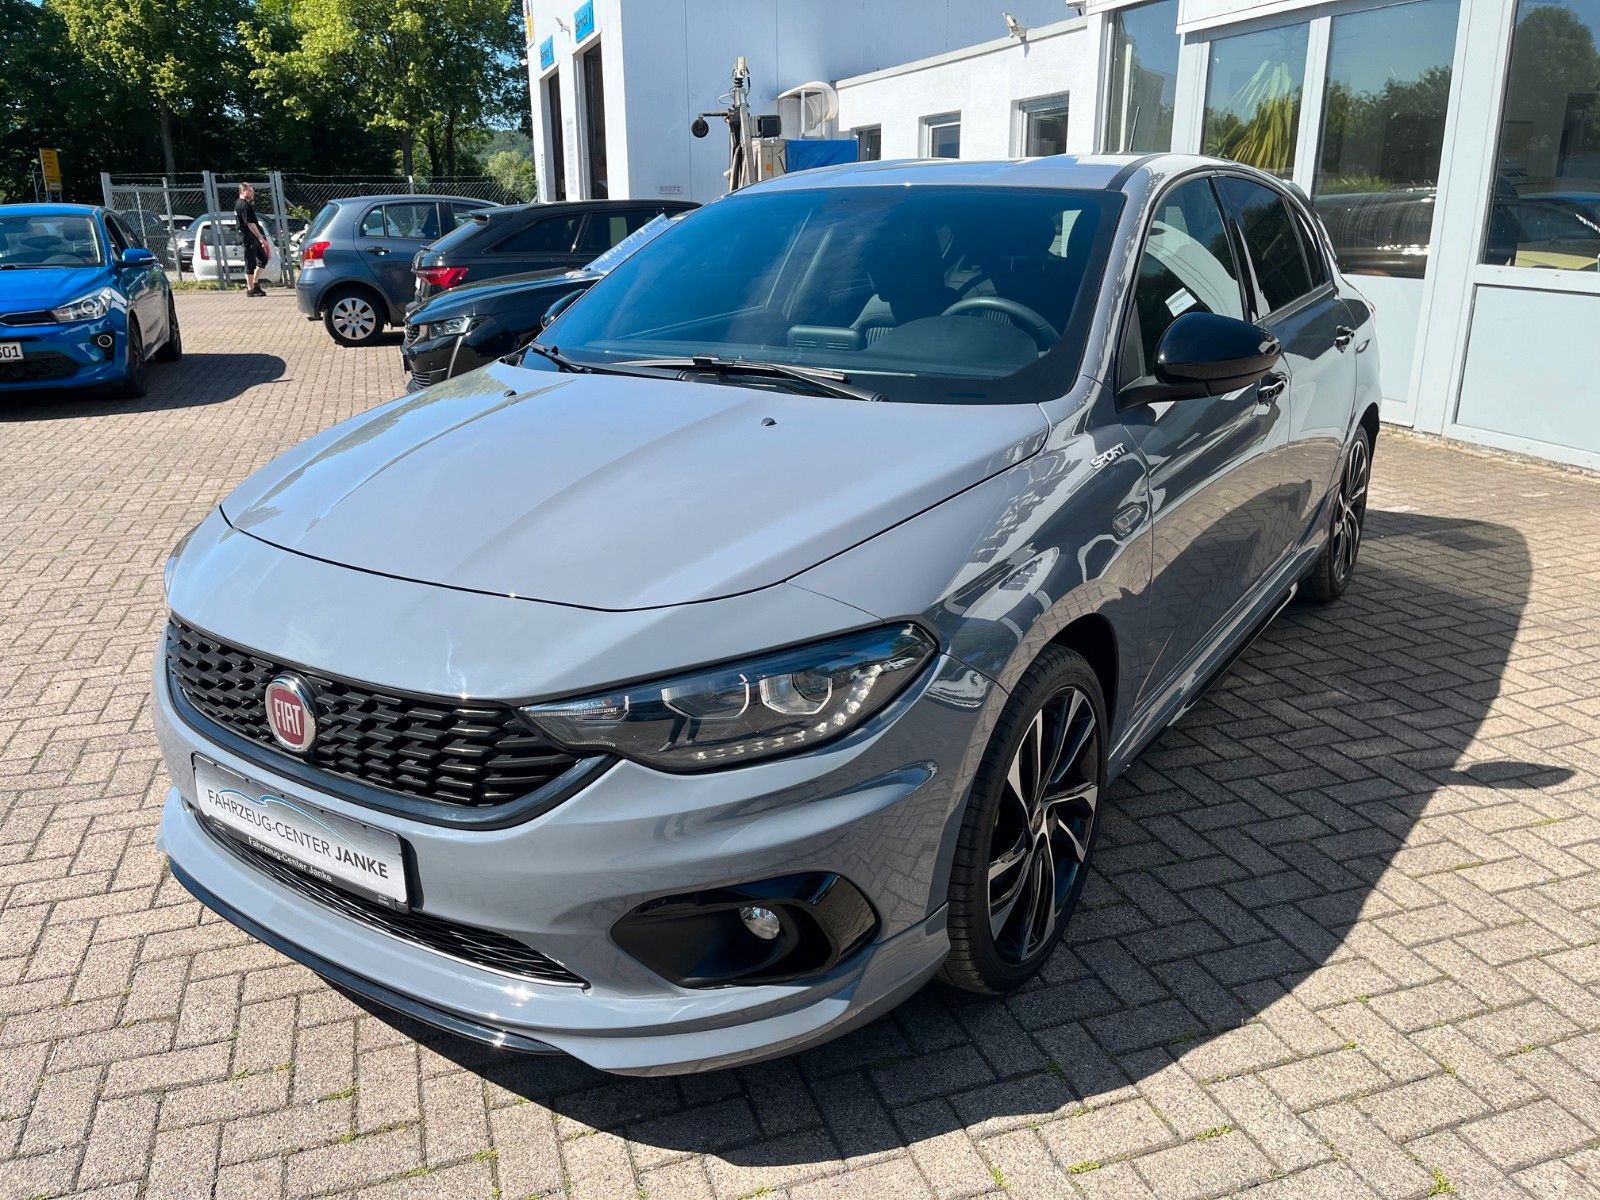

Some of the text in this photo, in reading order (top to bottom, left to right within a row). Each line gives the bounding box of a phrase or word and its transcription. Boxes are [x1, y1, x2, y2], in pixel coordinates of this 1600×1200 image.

[1091, 443, 1125, 470] SPORT
[274, 698, 302, 737] FIAT
[207, 789, 331, 857] FAHRZEUG-CENTER
[335, 846, 389, 879] JANKE
[248, 836, 332, 882] Fahrzeug-Center Janke
